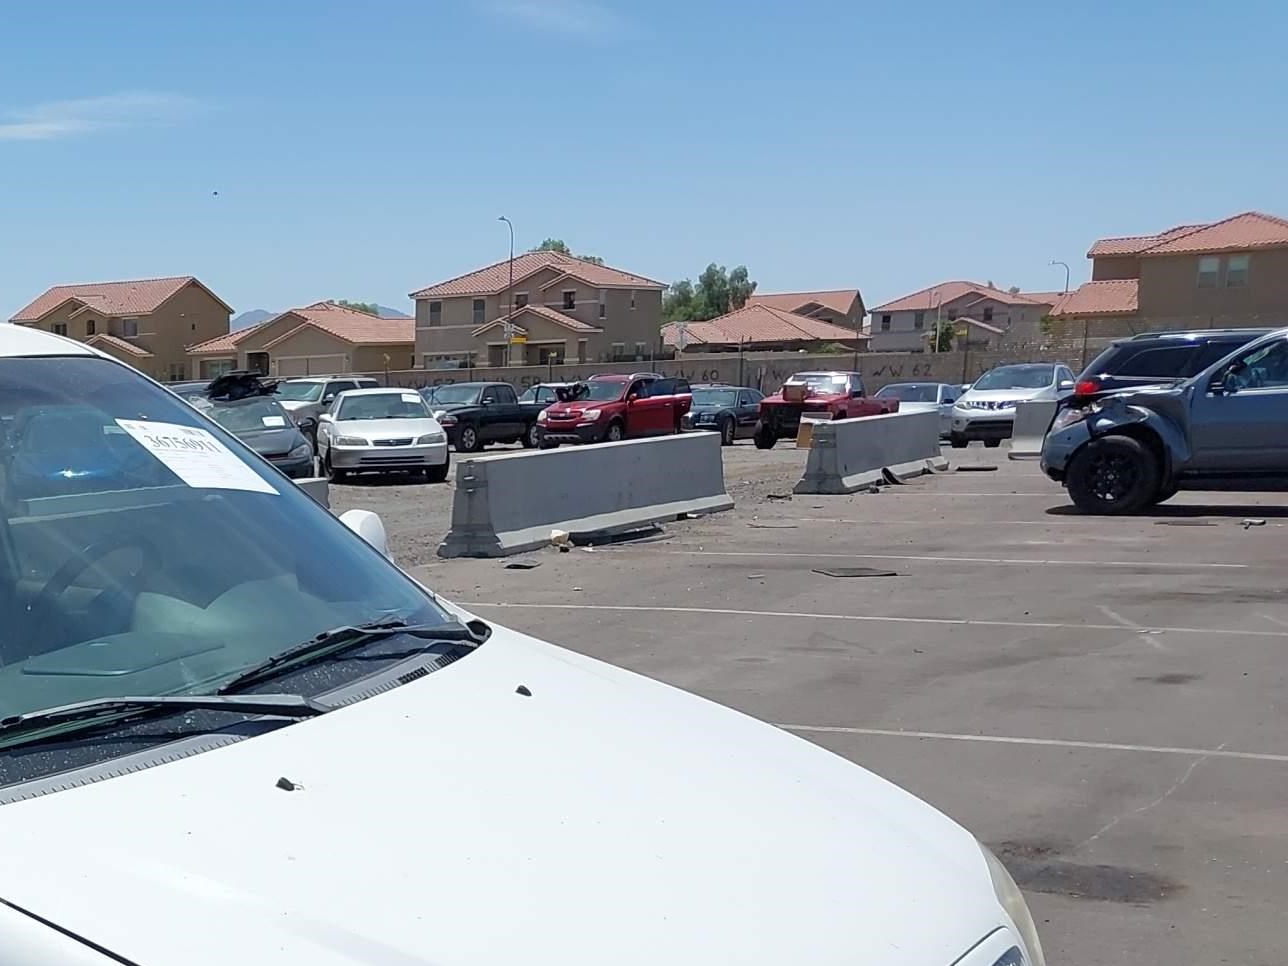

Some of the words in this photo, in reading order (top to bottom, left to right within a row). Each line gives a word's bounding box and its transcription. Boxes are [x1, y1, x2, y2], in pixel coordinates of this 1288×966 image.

[701, 369, 720, 382] 60
[912, 364, 933, 377] 62
[144, 434, 223, 454] 36756911
